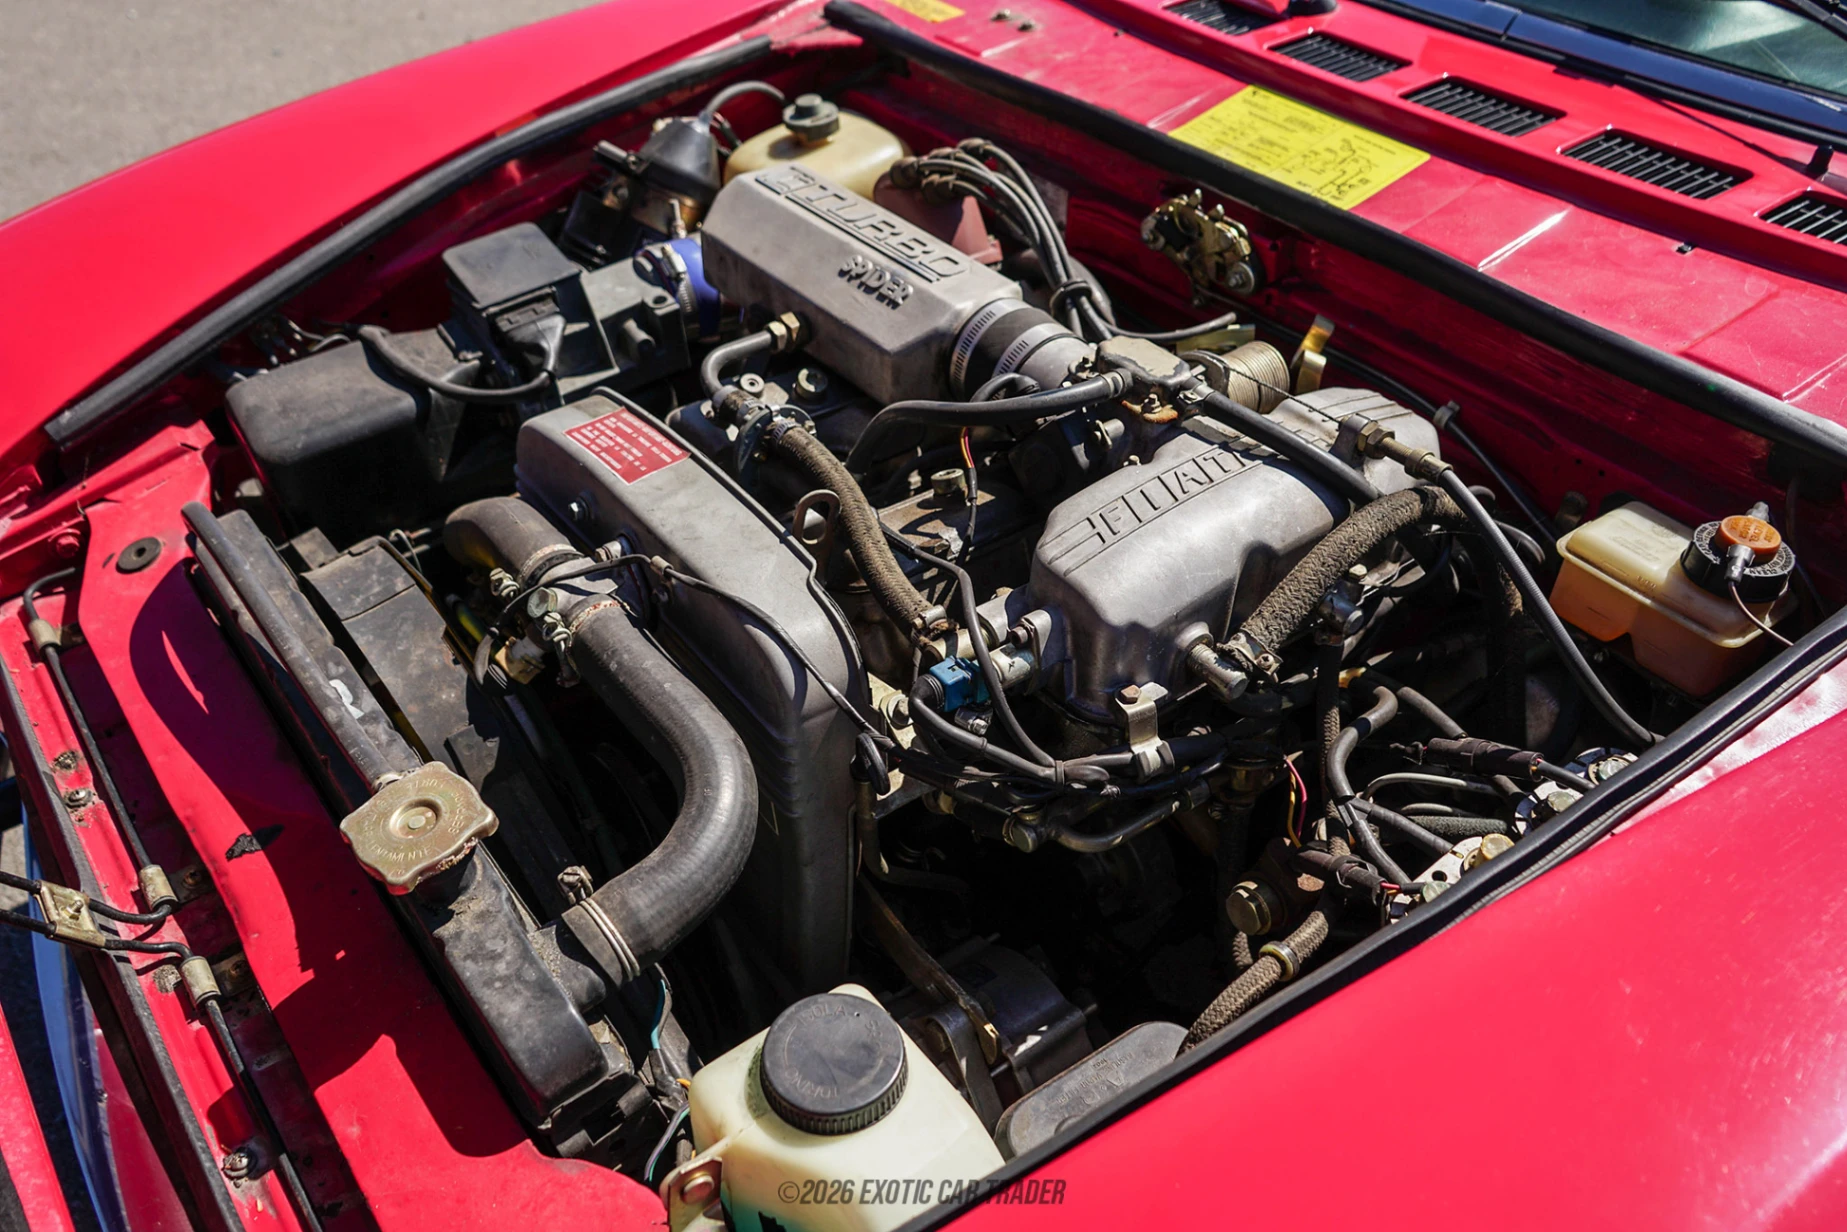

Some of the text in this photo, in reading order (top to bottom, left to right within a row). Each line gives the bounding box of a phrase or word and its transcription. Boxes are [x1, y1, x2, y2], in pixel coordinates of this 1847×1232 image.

[805, 184, 969, 277] TURBO
[838, 254, 914, 307] SPIDER
[1098, 451, 1231, 536] FIAT
